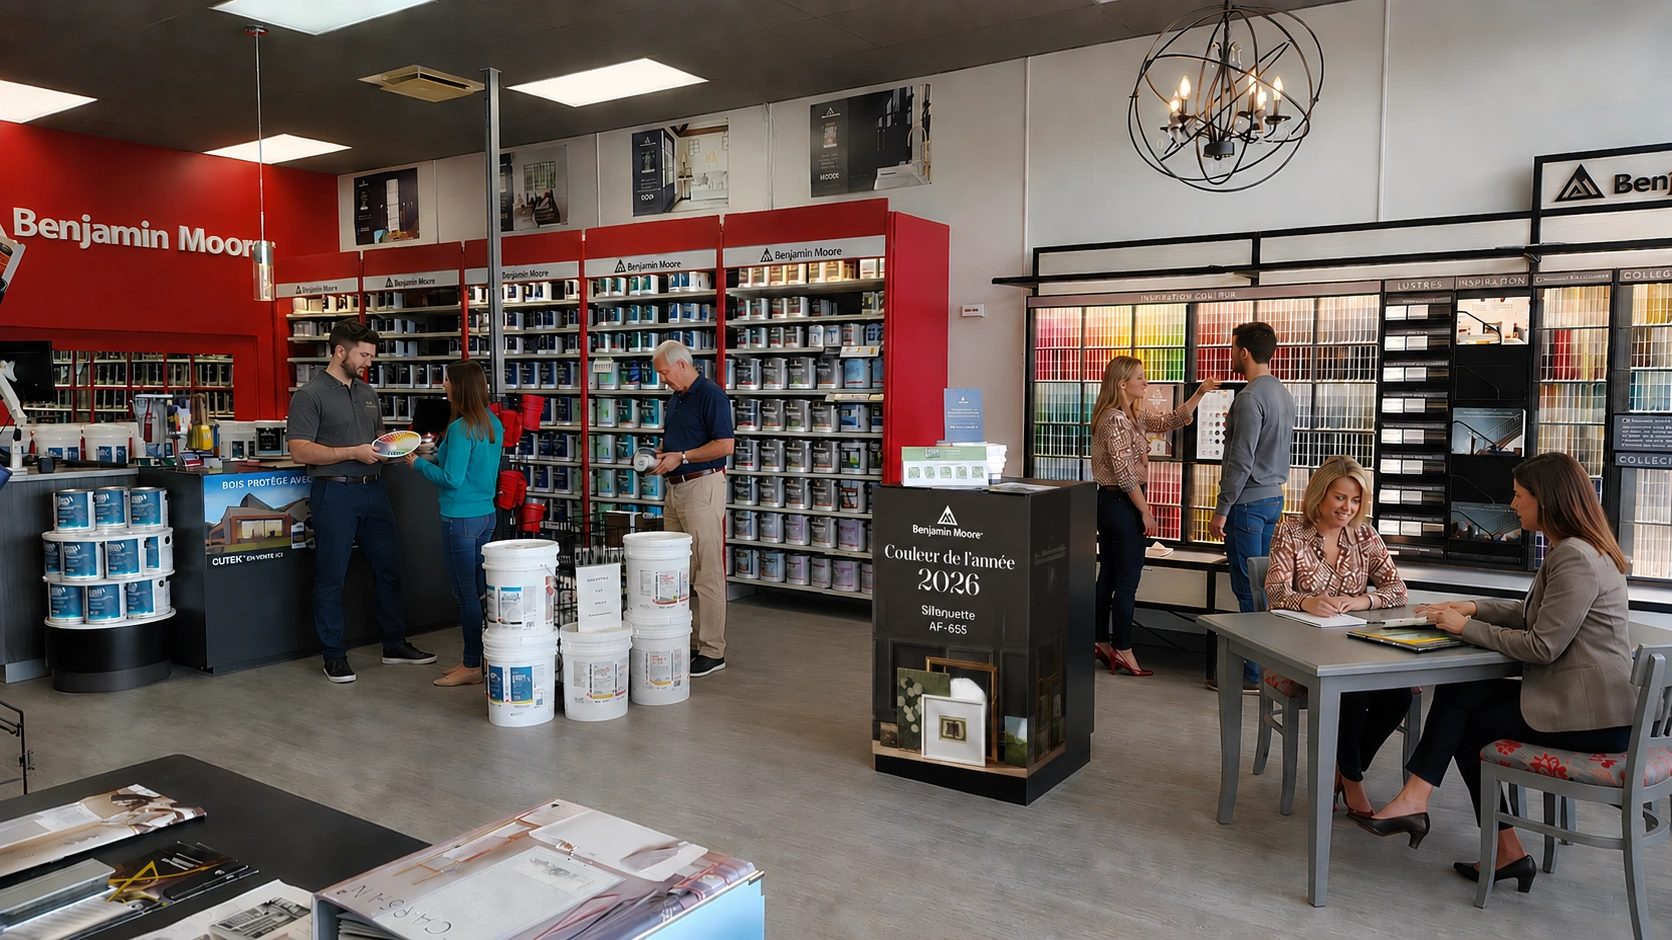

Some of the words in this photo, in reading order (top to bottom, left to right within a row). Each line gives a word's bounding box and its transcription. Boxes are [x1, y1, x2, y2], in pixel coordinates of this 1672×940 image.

[13, 207, 169, 249] Benjamin
[775, 248, 813, 261] Benjamin
[814, 247, 842, 257] Moore
[627, 262, 658, 272] Benjamin
[659, 260, 681, 269] Moore
[1397, 281, 1442, 291] LUSTRES
[1458, 277, 1526, 287] INSPIRATION
[222, 480, 244, 490] BOIS
[289, 475, 313, 485] AVEC
[912, 524, 952, 537] Benjamin
[212, 555, 243, 566] CUTEK
[884, 543, 941, 563] Couleur
[943, 549, 961, 566] de
[964, 551, 1016, 571] l'année
[918, 567, 981, 596] 2026
